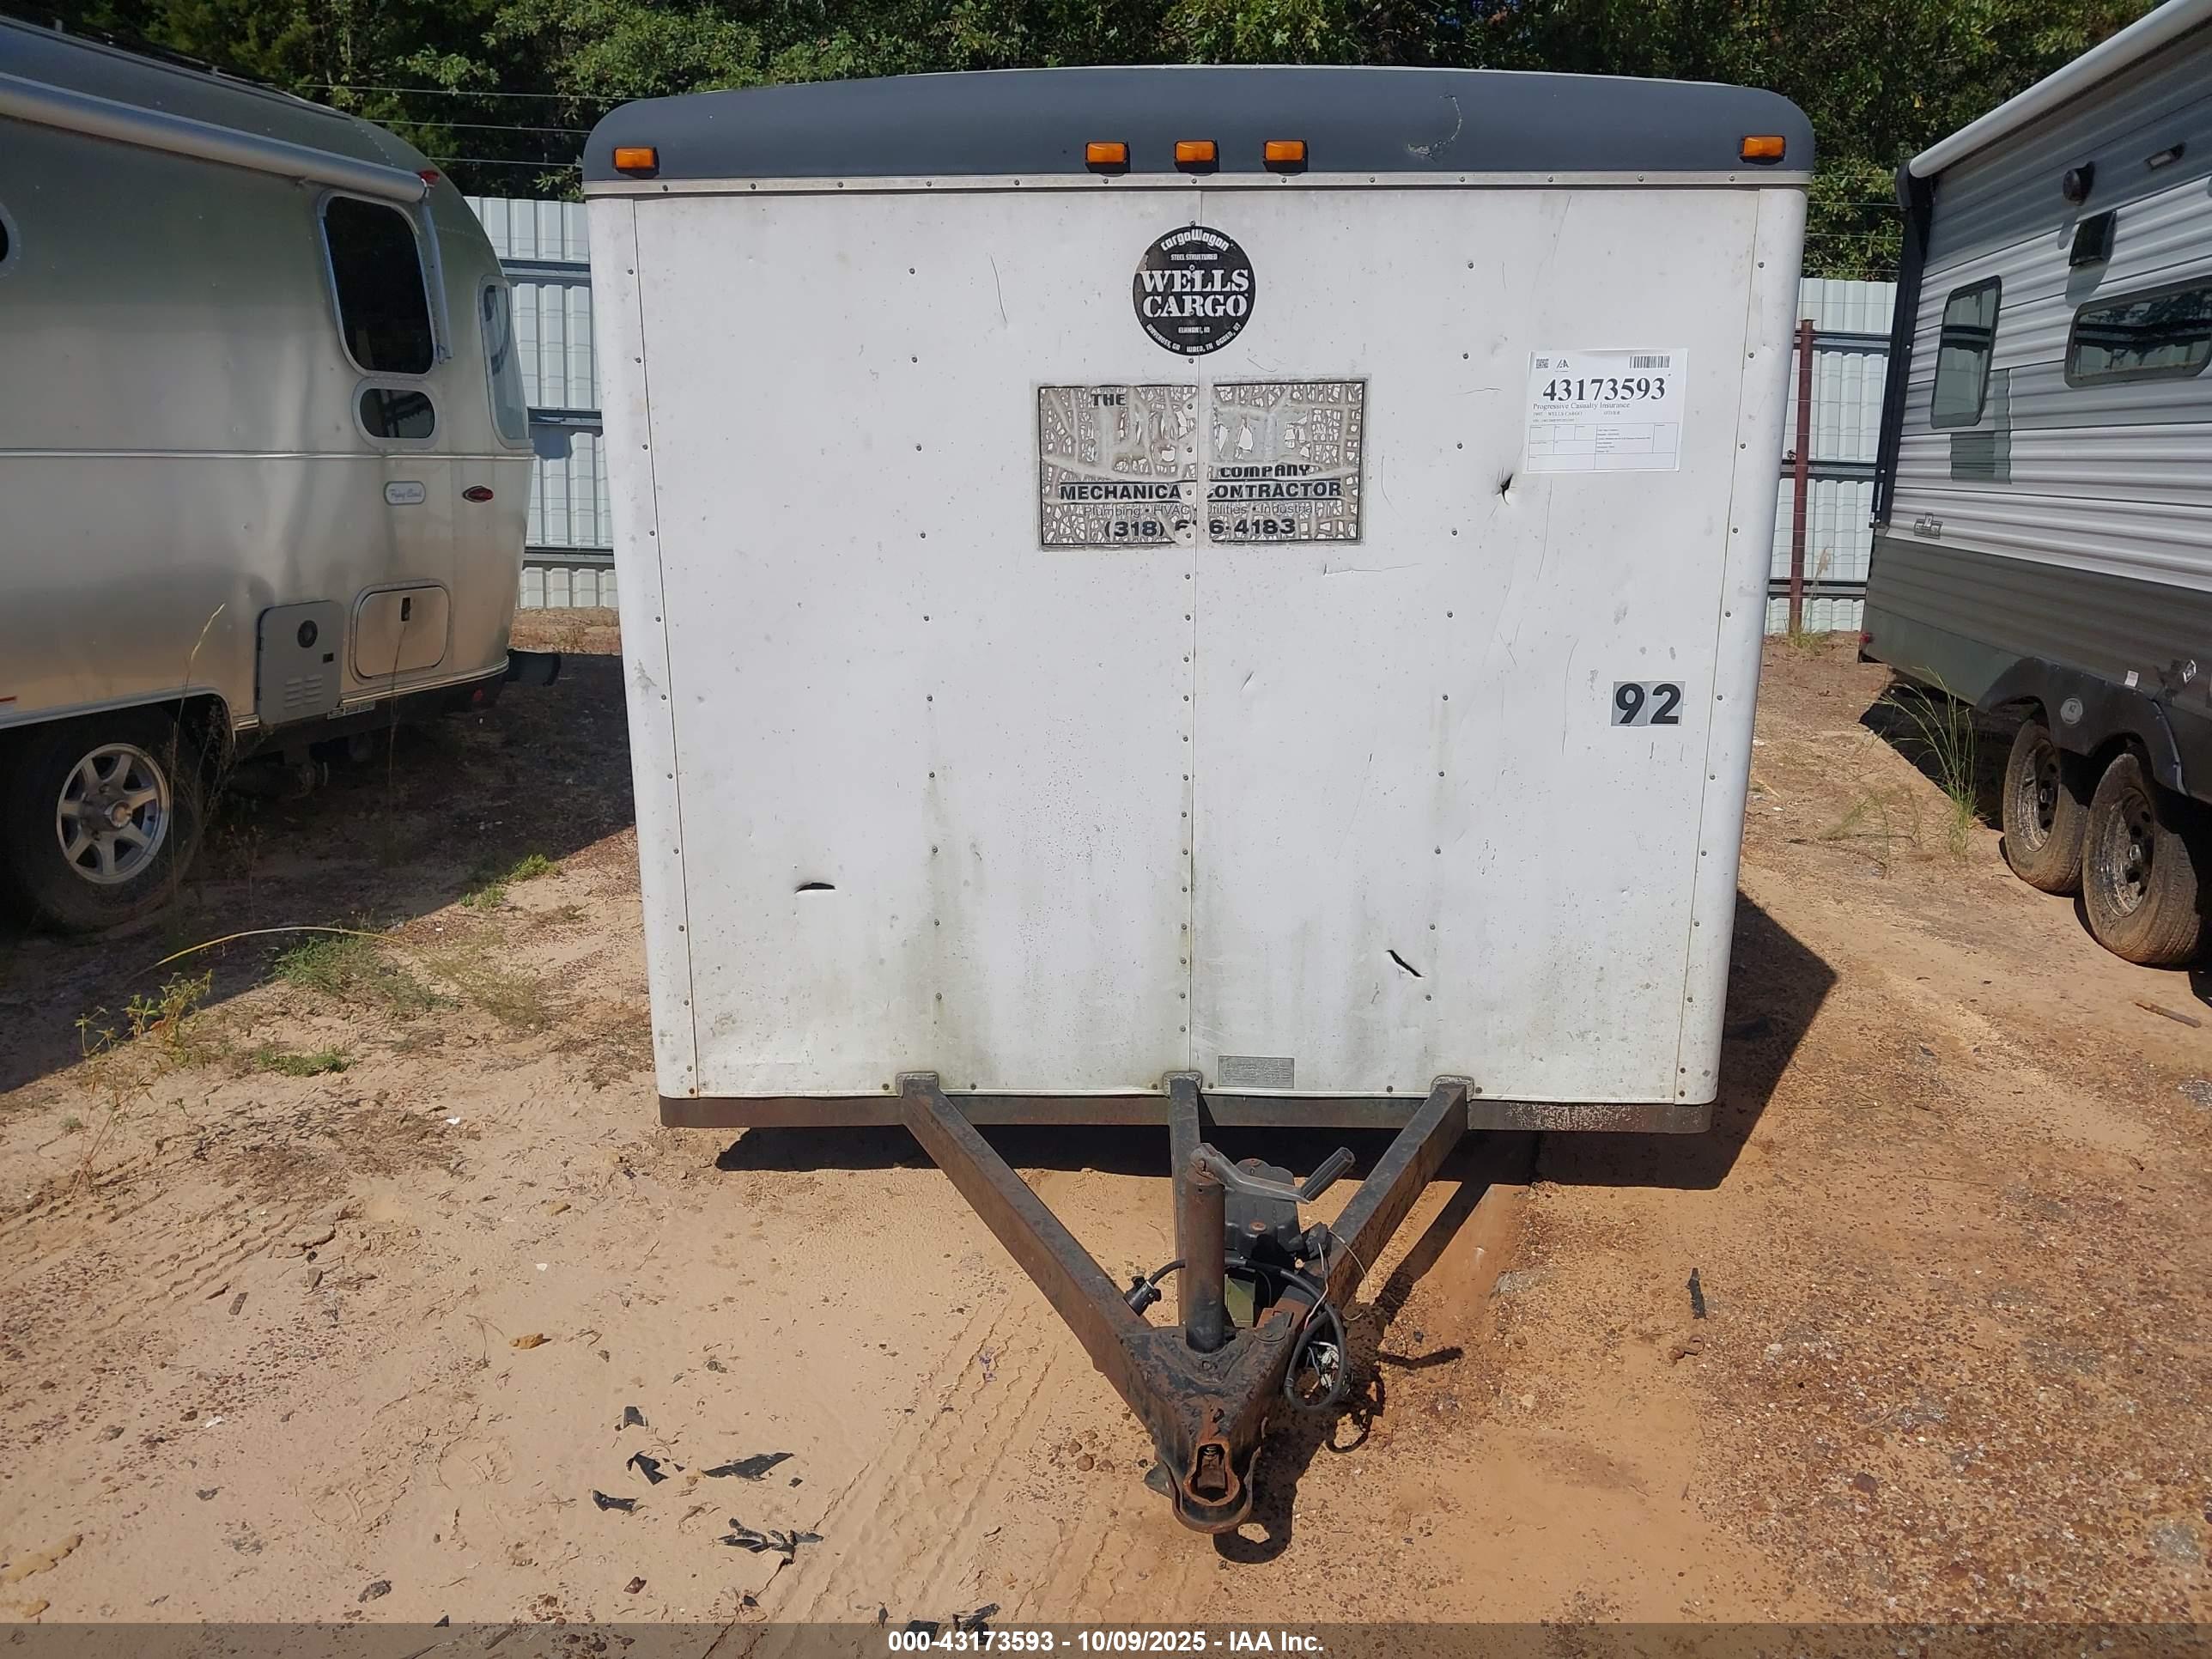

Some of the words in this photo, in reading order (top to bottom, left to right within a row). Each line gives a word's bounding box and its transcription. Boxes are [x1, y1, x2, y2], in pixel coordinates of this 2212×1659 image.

[1160, 228, 1231, 252] cargoWagon
[1140, 269, 1249, 292] WELLS
[1143, 295, 1247, 318] CARGO
[1543, 378, 1666, 401] 43173593
[1091, 393, 1127, 406] THE
[1533, 403, 1569, 411] Progressive
[1220, 465, 1310, 477] COMPANY
[1060, 485, 1182, 500] MECHANICA
[1084, 505, 1141, 518] Plumbing
[1153, 505, 1191, 515] HVAC
[1104, 520, 1164, 537] (318)
[1616, 683, 1681, 724] 92
